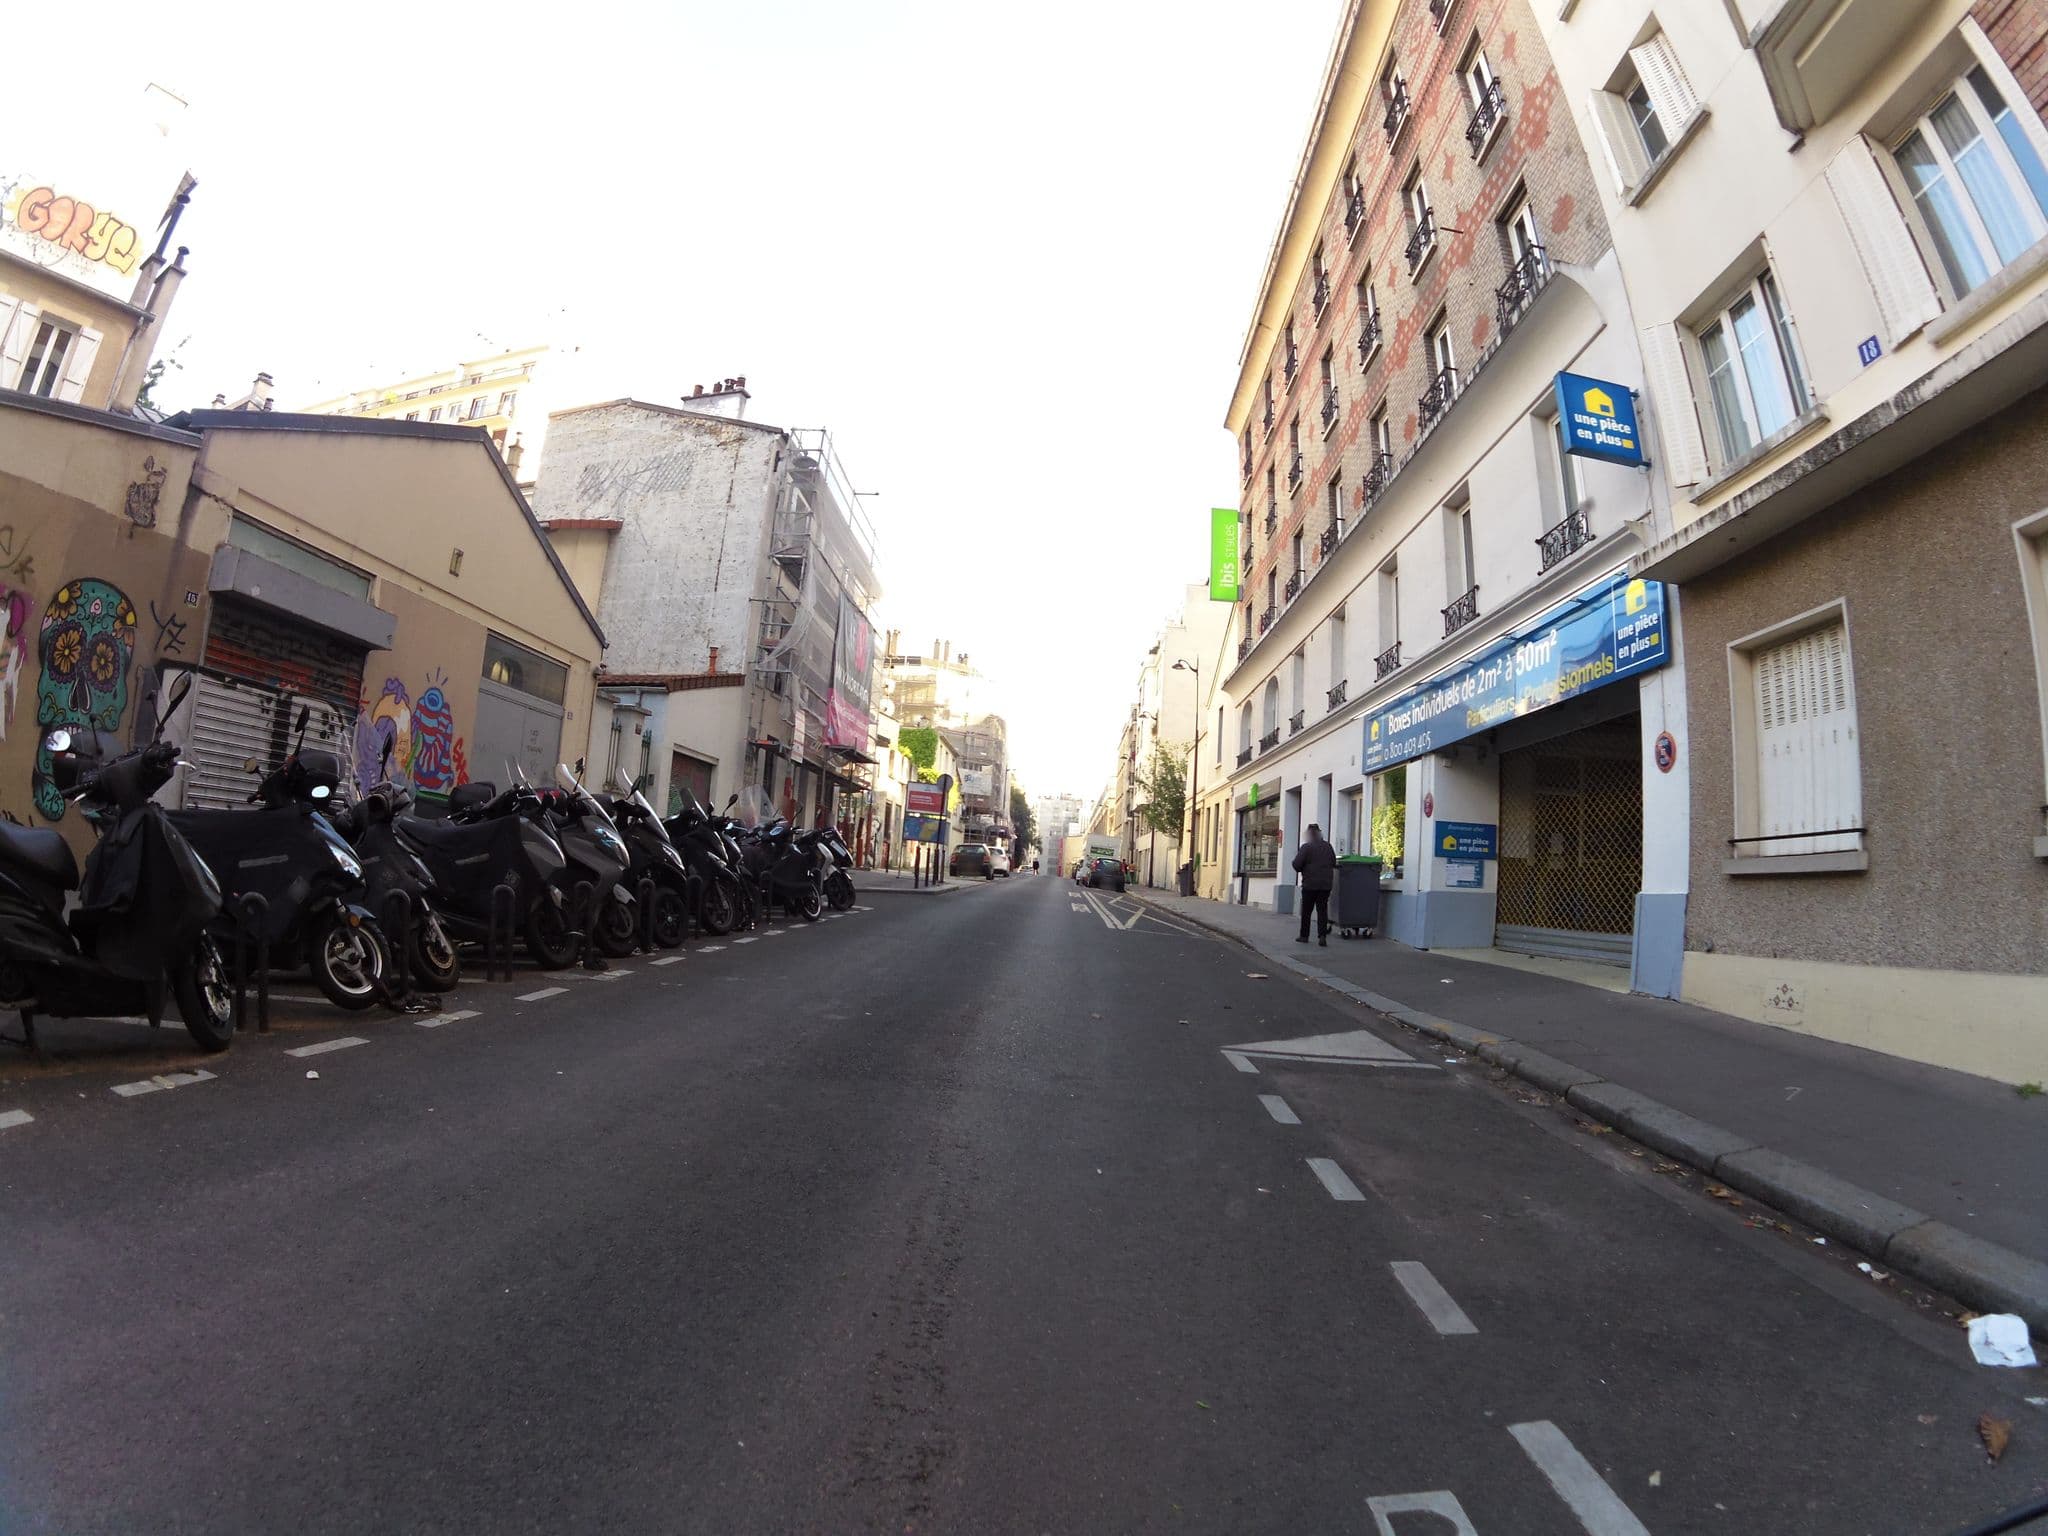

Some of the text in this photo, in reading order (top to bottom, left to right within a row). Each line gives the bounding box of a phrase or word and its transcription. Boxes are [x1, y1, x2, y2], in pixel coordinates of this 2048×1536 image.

[1862, 340, 1878, 362] 18
[1574, 413, 1631, 434] une pièce
[1577, 428, 1622, 446] en plus
[1220, 562, 1235, 588] ibis
[1618, 613, 1658, 640] une pièce
[1618, 637, 1650, 659] en plus
[1388, 709, 1412, 736] Boxes
[1412, 681, 1460, 726] individuels
[1461, 674, 1476, 701] de
[1505, 654, 1513, 681] à
[1390, 742, 1403, 759] 800
[1404, 737, 1416, 757] 403
